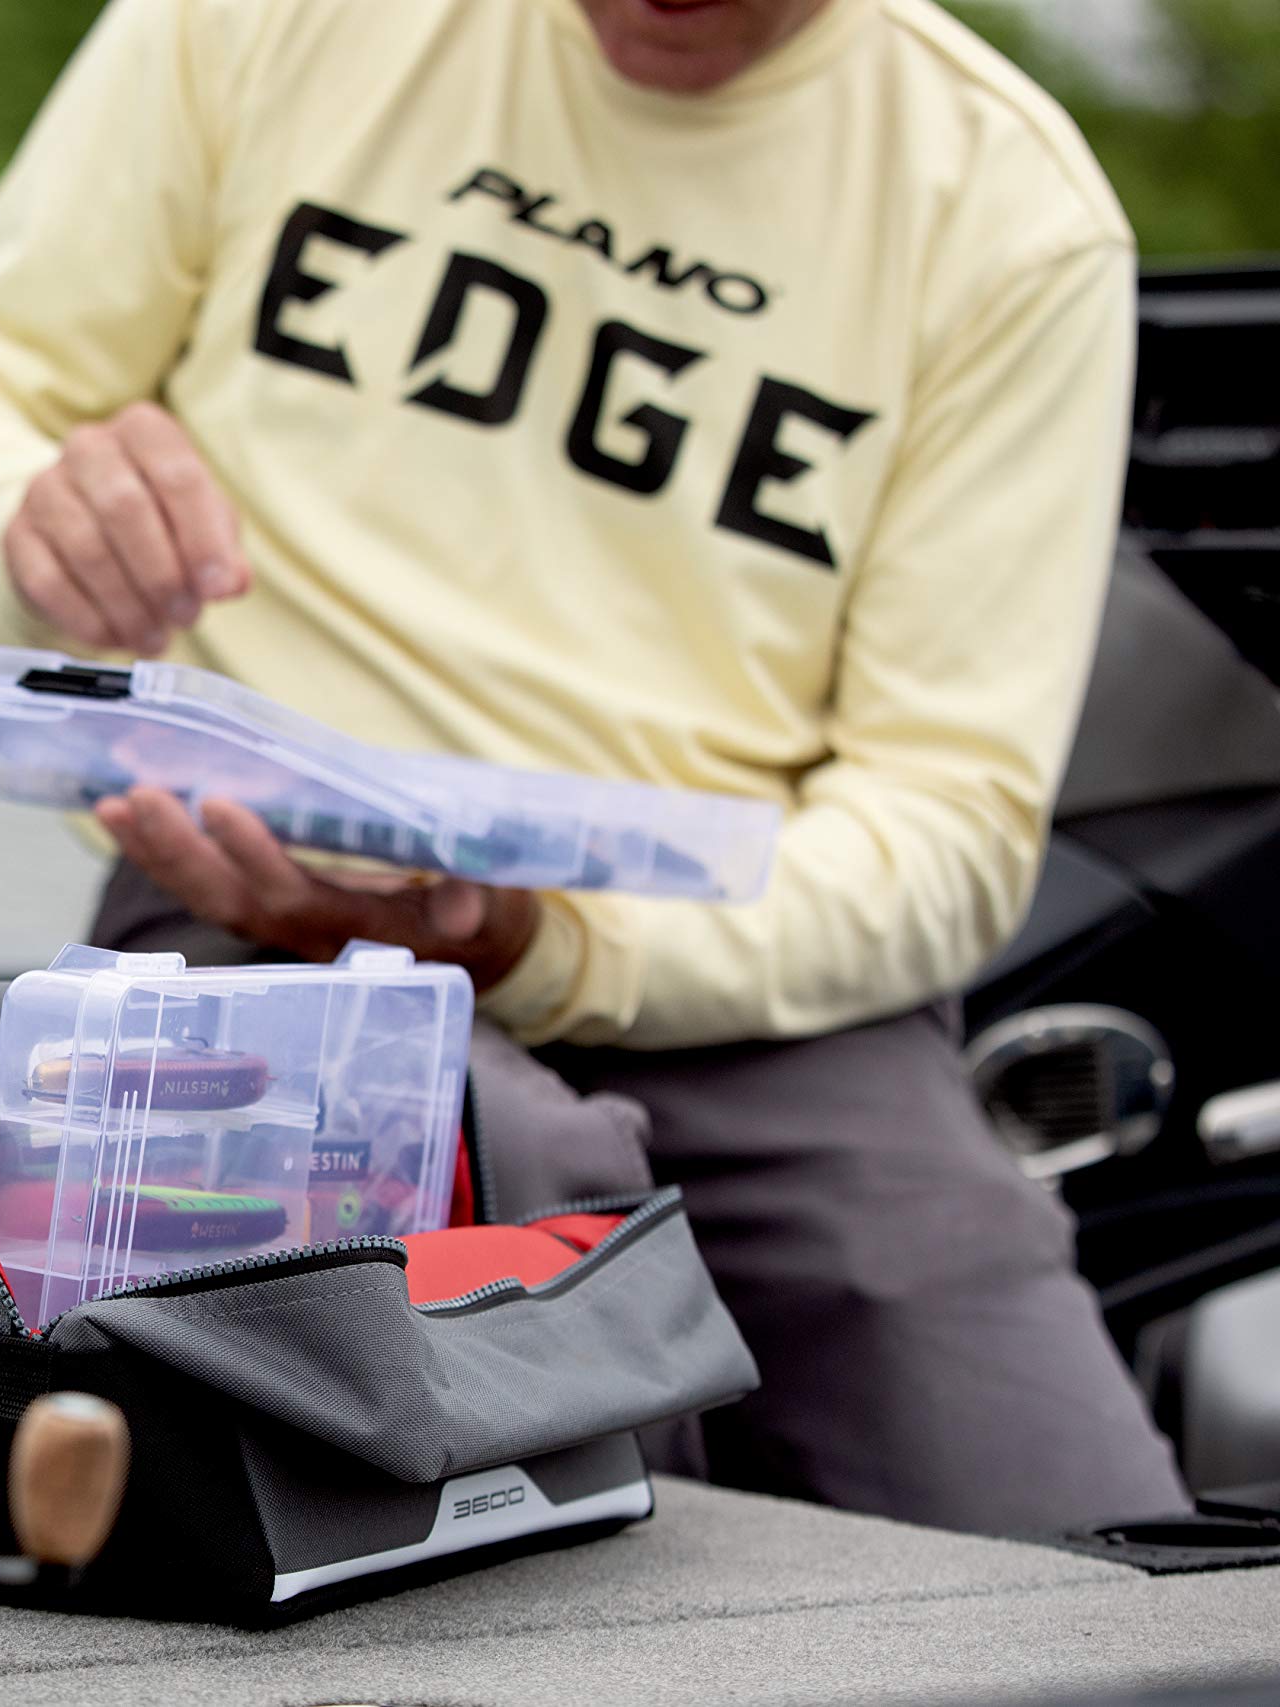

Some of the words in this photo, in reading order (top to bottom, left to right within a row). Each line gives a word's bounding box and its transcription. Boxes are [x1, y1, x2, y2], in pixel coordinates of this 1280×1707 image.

[447, 167, 769, 315] PLANO
[252, 201, 880, 573] EDGE
[164, 1080, 220, 1095] WESTIN
[309, 1151, 361, 1172] ESTIN
[452, 1486, 525, 1520] 3600
